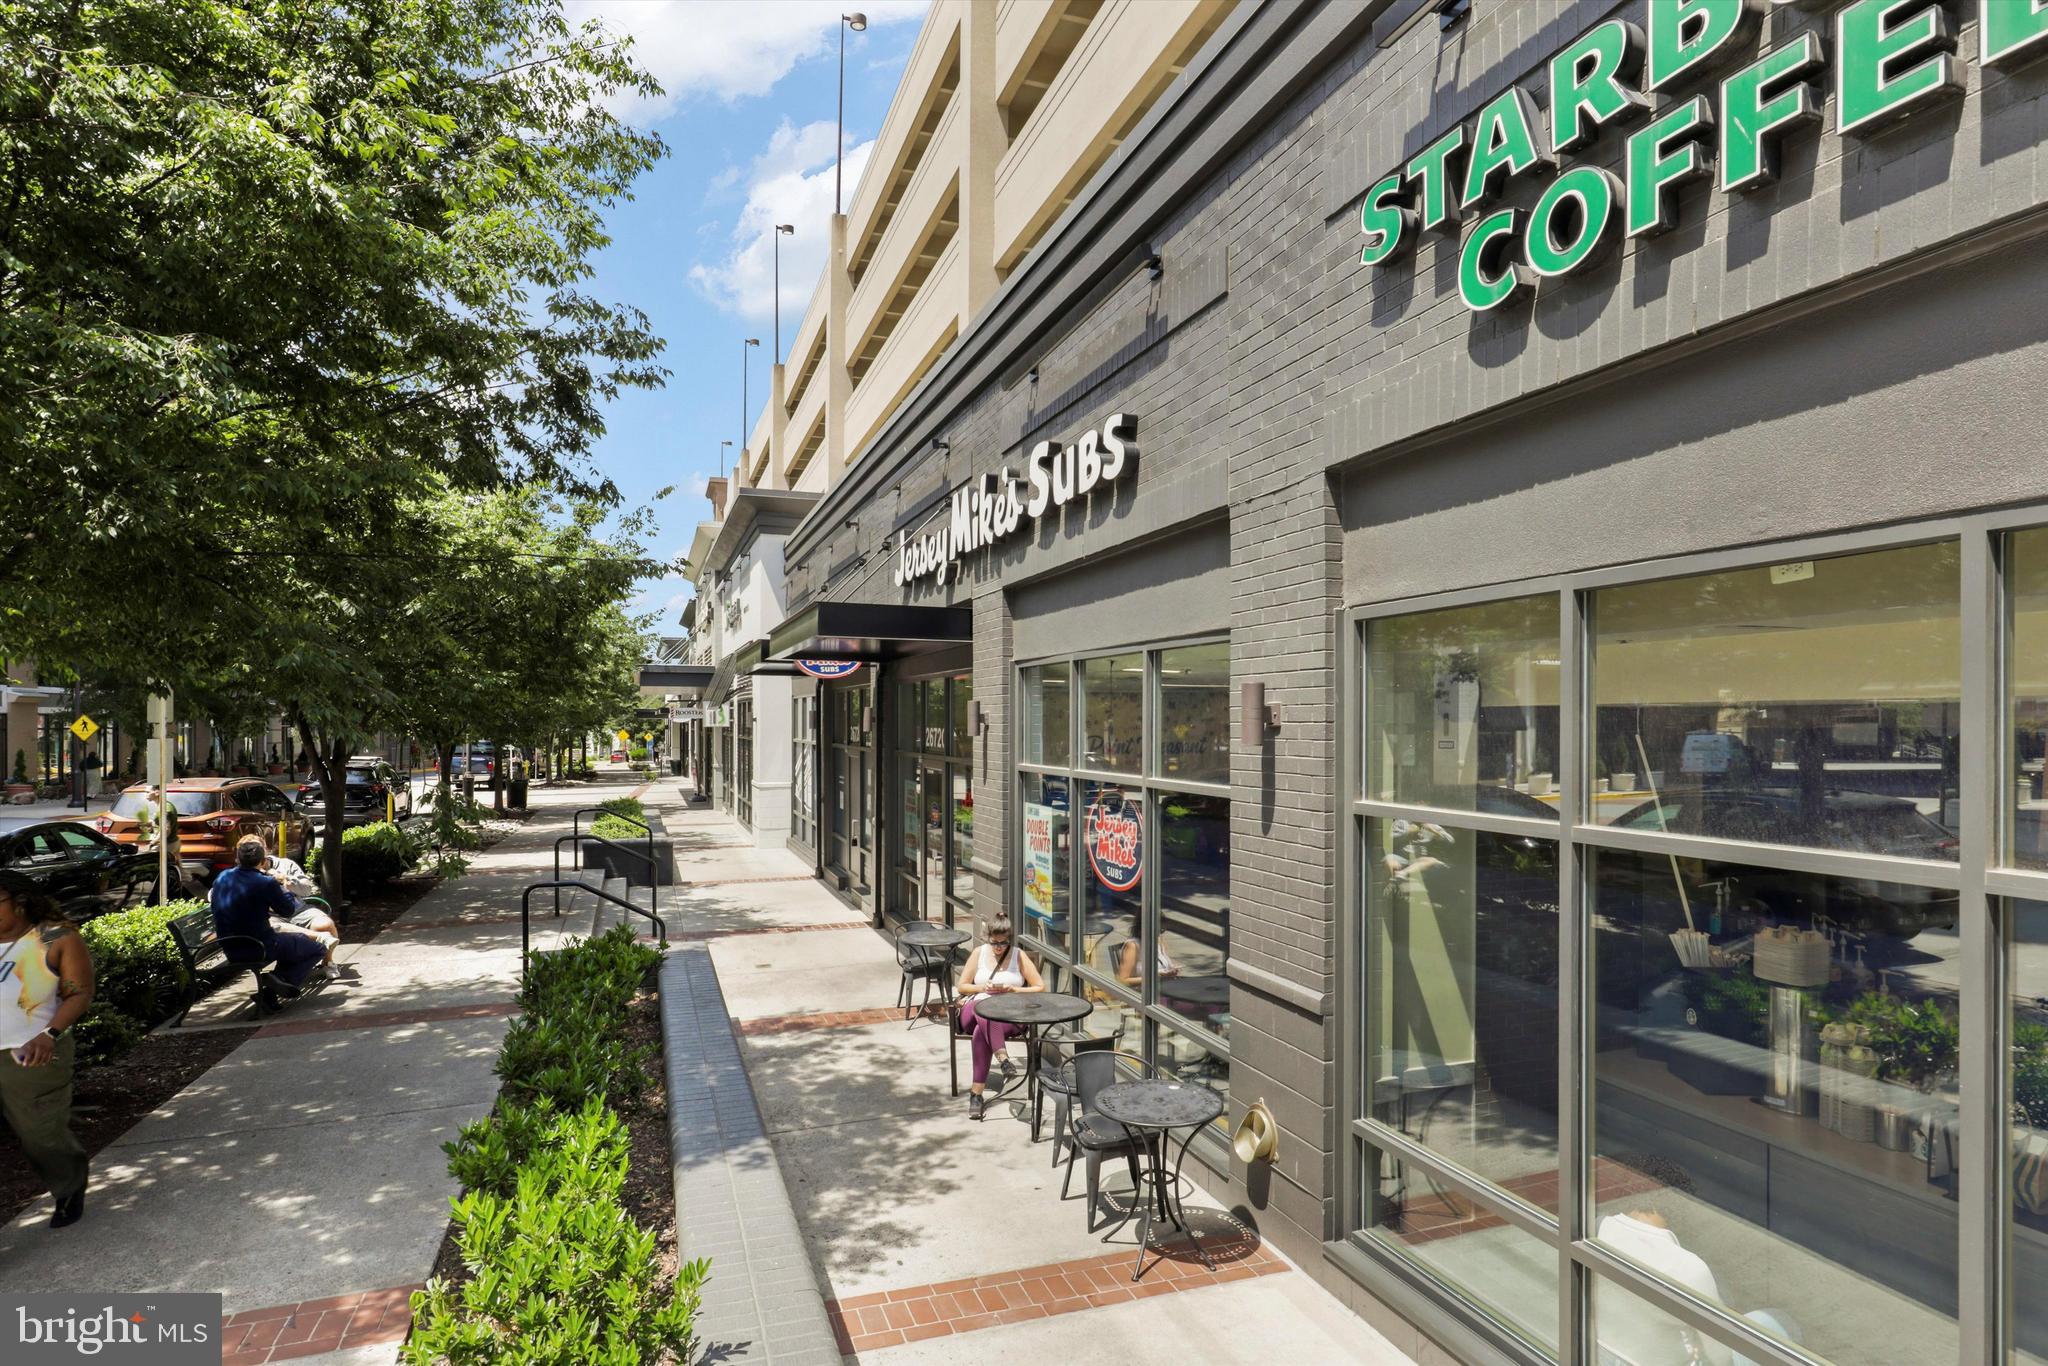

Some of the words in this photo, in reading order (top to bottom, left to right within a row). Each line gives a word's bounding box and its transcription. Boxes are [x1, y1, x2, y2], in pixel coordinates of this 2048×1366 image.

[1360, 0, 1765, 266] STARB
[895, 527, 948, 587] Jersey
[949, 466, 1024, 560] Mike's
[1026, 818, 1049, 836] DOUBLE
[1096, 806, 1137, 848] Jersey
[1030, 836, 1051, 854] POINTS
[1106, 865, 1123, 880] SUBS
